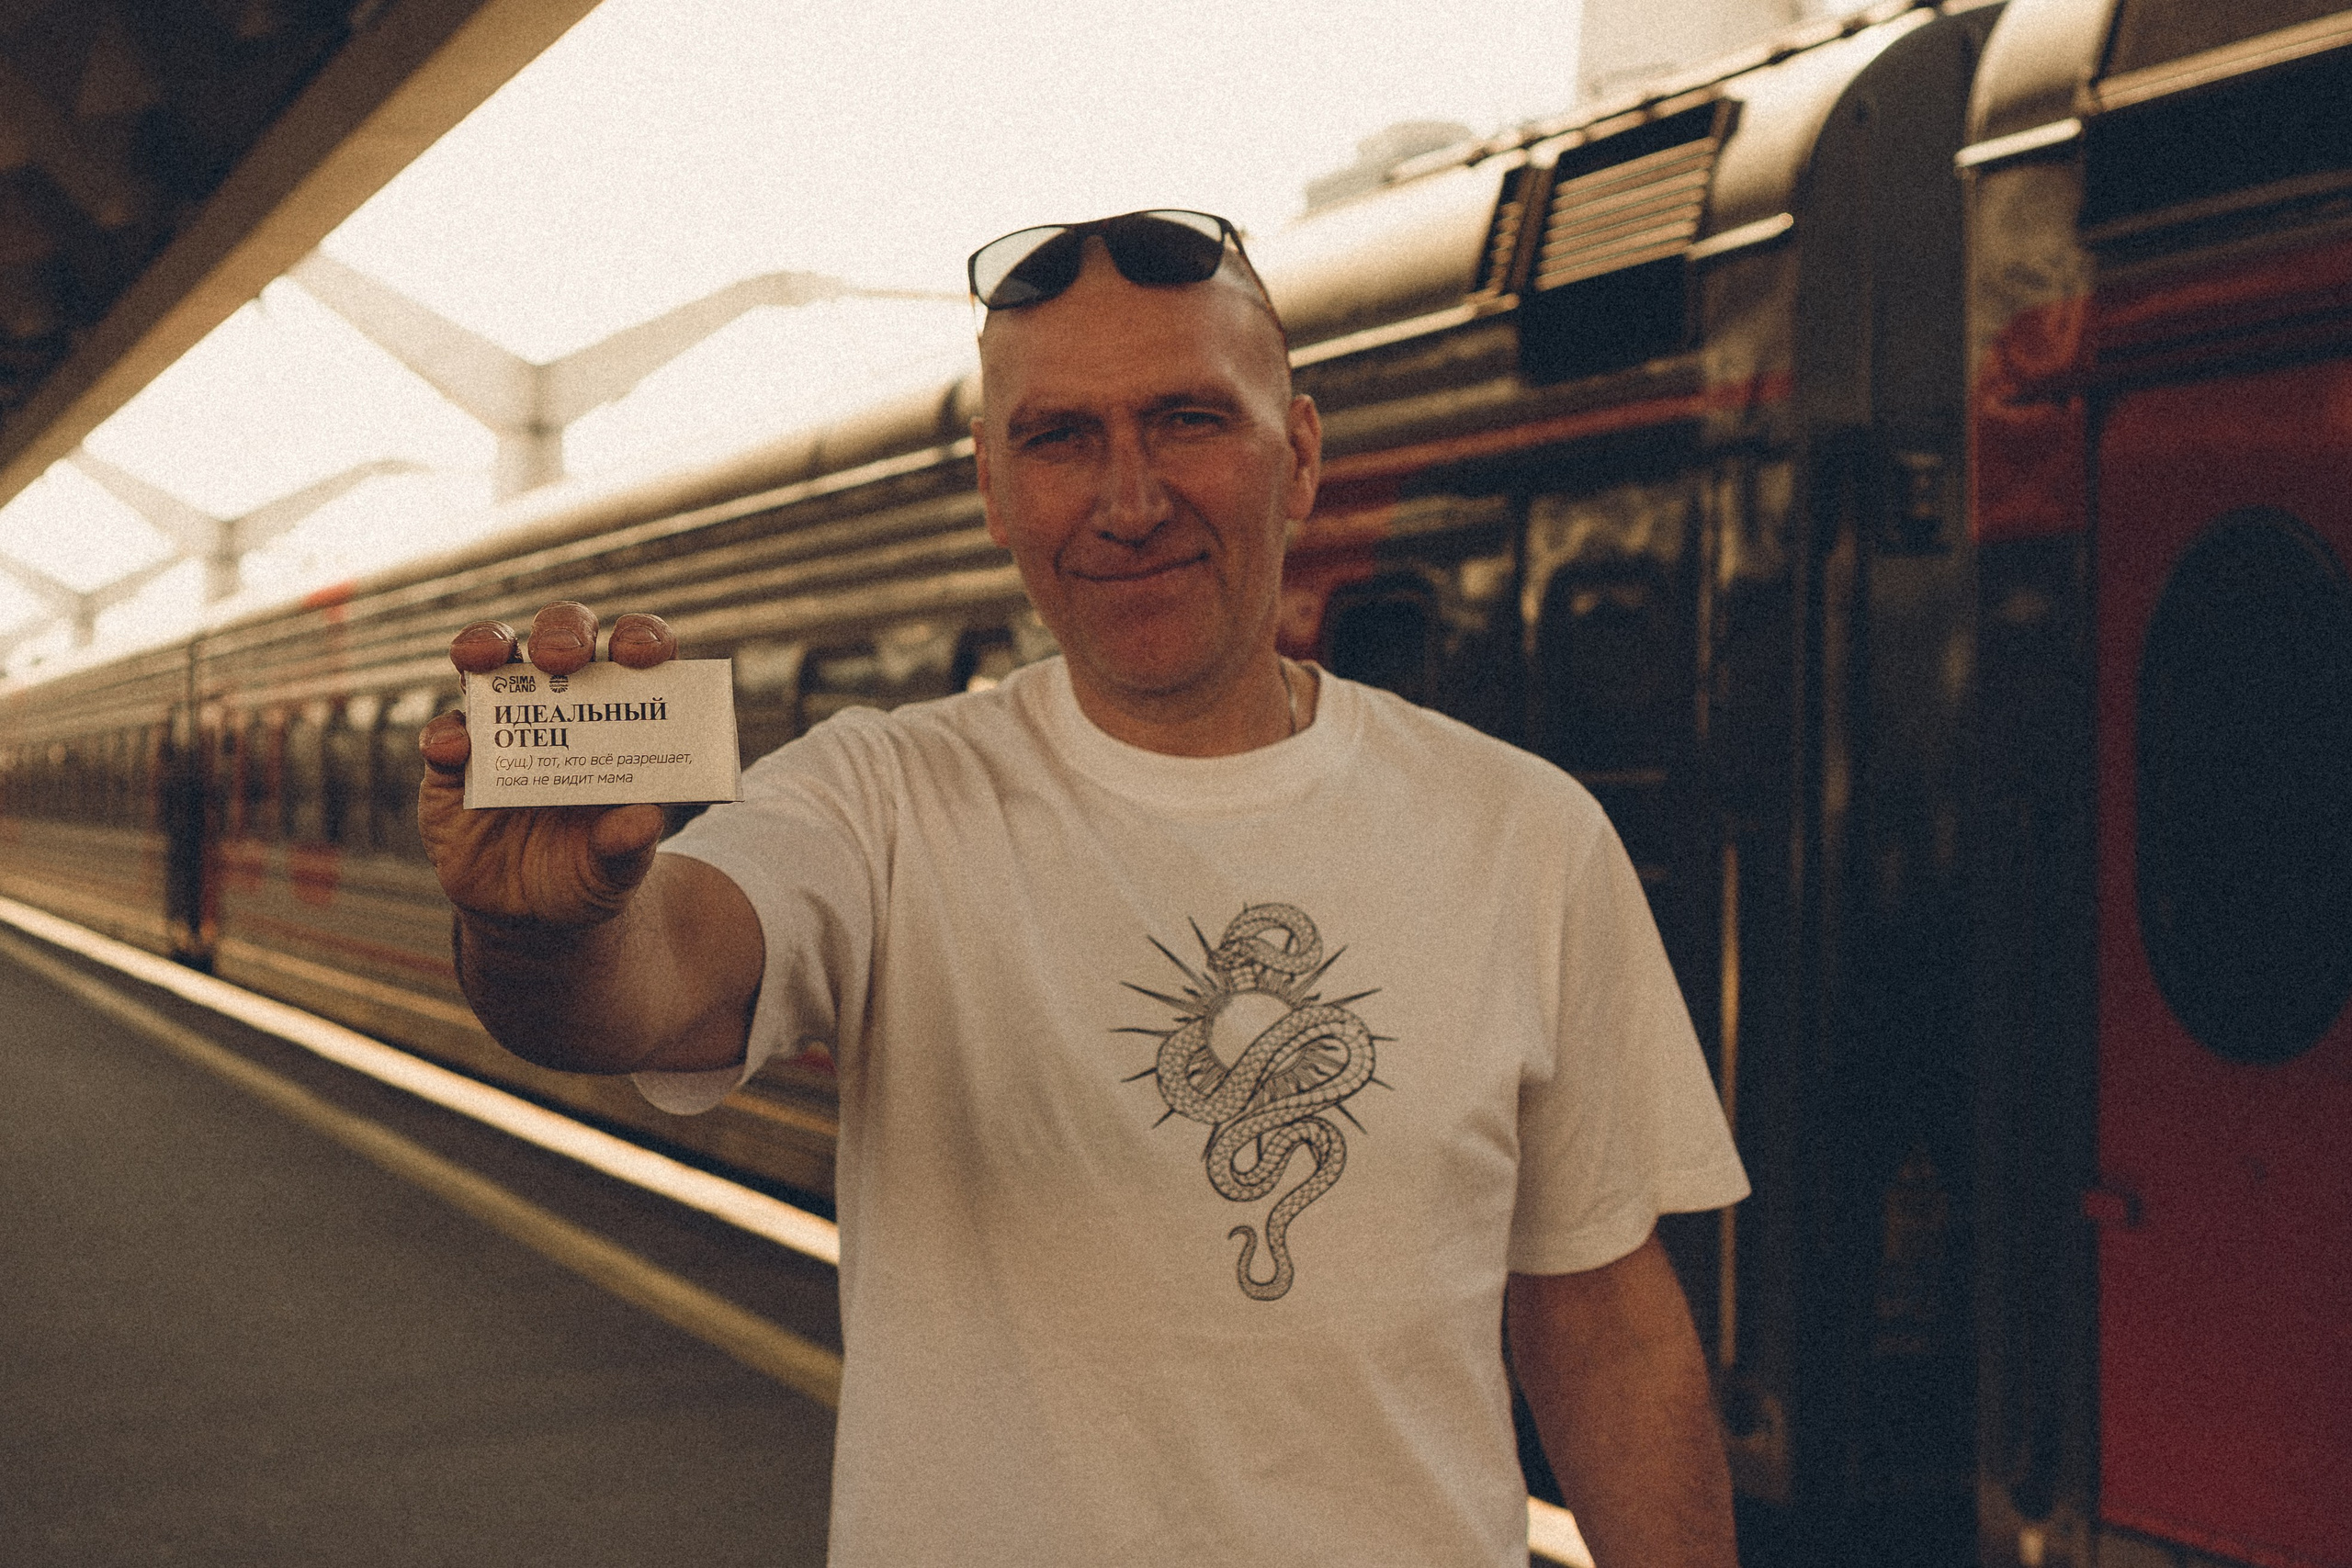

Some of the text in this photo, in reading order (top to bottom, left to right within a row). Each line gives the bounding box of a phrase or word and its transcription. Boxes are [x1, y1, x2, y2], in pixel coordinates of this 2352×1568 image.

[509, 675, 536, 684] SIMA
[509, 684, 537, 693] LAND
[493, 696, 668, 728] ИДЕАЛЬНЫЙ
[494, 728, 570, 750] ОТЕЦ
[495, 753, 693, 771] (сущ.) тот, кто всё разрешает,
[496, 773, 634, 786] пока не видит мама
